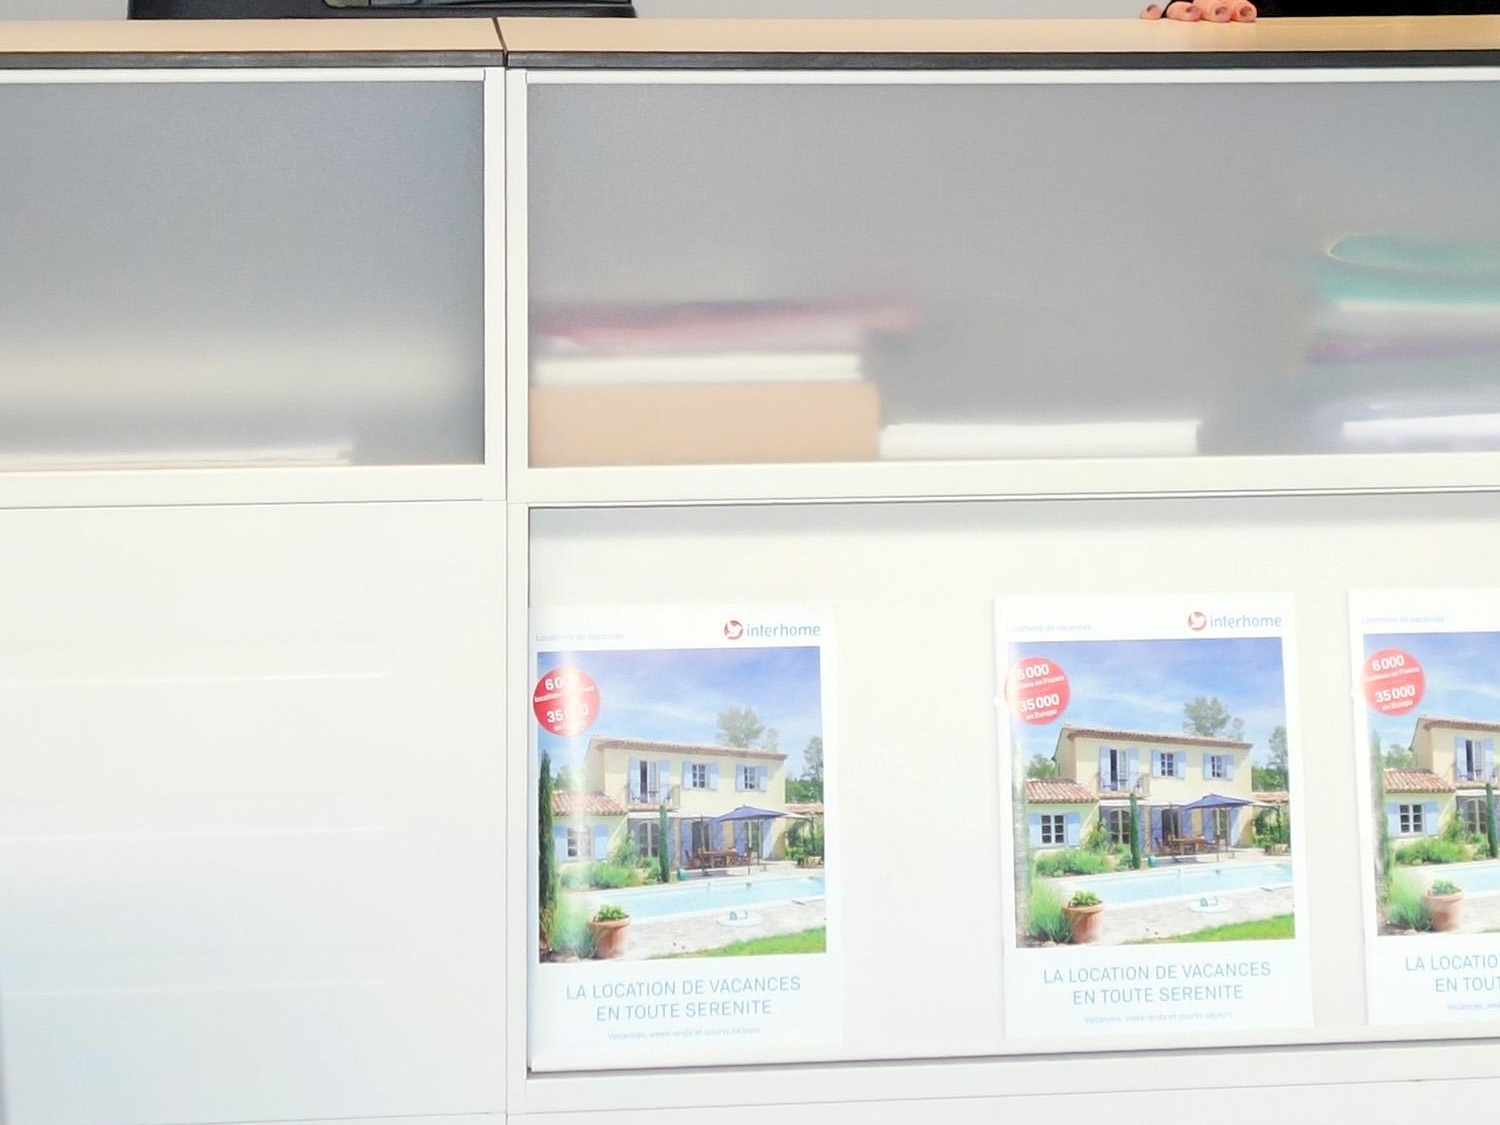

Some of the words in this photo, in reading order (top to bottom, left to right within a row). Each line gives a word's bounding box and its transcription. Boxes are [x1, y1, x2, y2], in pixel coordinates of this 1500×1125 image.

[1209, 613, 1282, 628] interhome
[746, 623, 821, 638] interhome
[1043, 969, 1064, 984] LA
[1069, 966, 1150, 983] LOCATION
[1156, 964, 1177, 979] DE
[1182, 961, 1272, 978] VACANCES
[1405, 957, 1426, 971] LA
[566, 985, 587, 1000] LA
[593, 981, 676, 999] LOCATION
[682, 979, 705, 995] DE
[709, 975, 801, 994] VACANCES
[1073, 990, 1096, 1005] EN
[1101, 987, 1154, 1004] TOUTE
[1159, 984, 1243, 1002] SERENITE
[1435, 978, 1458, 993] EN
[597, 1005, 620, 1021] EN
[625, 1003, 680, 1020] TOUTE
[685, 999, 772, 1018] SERENITE
